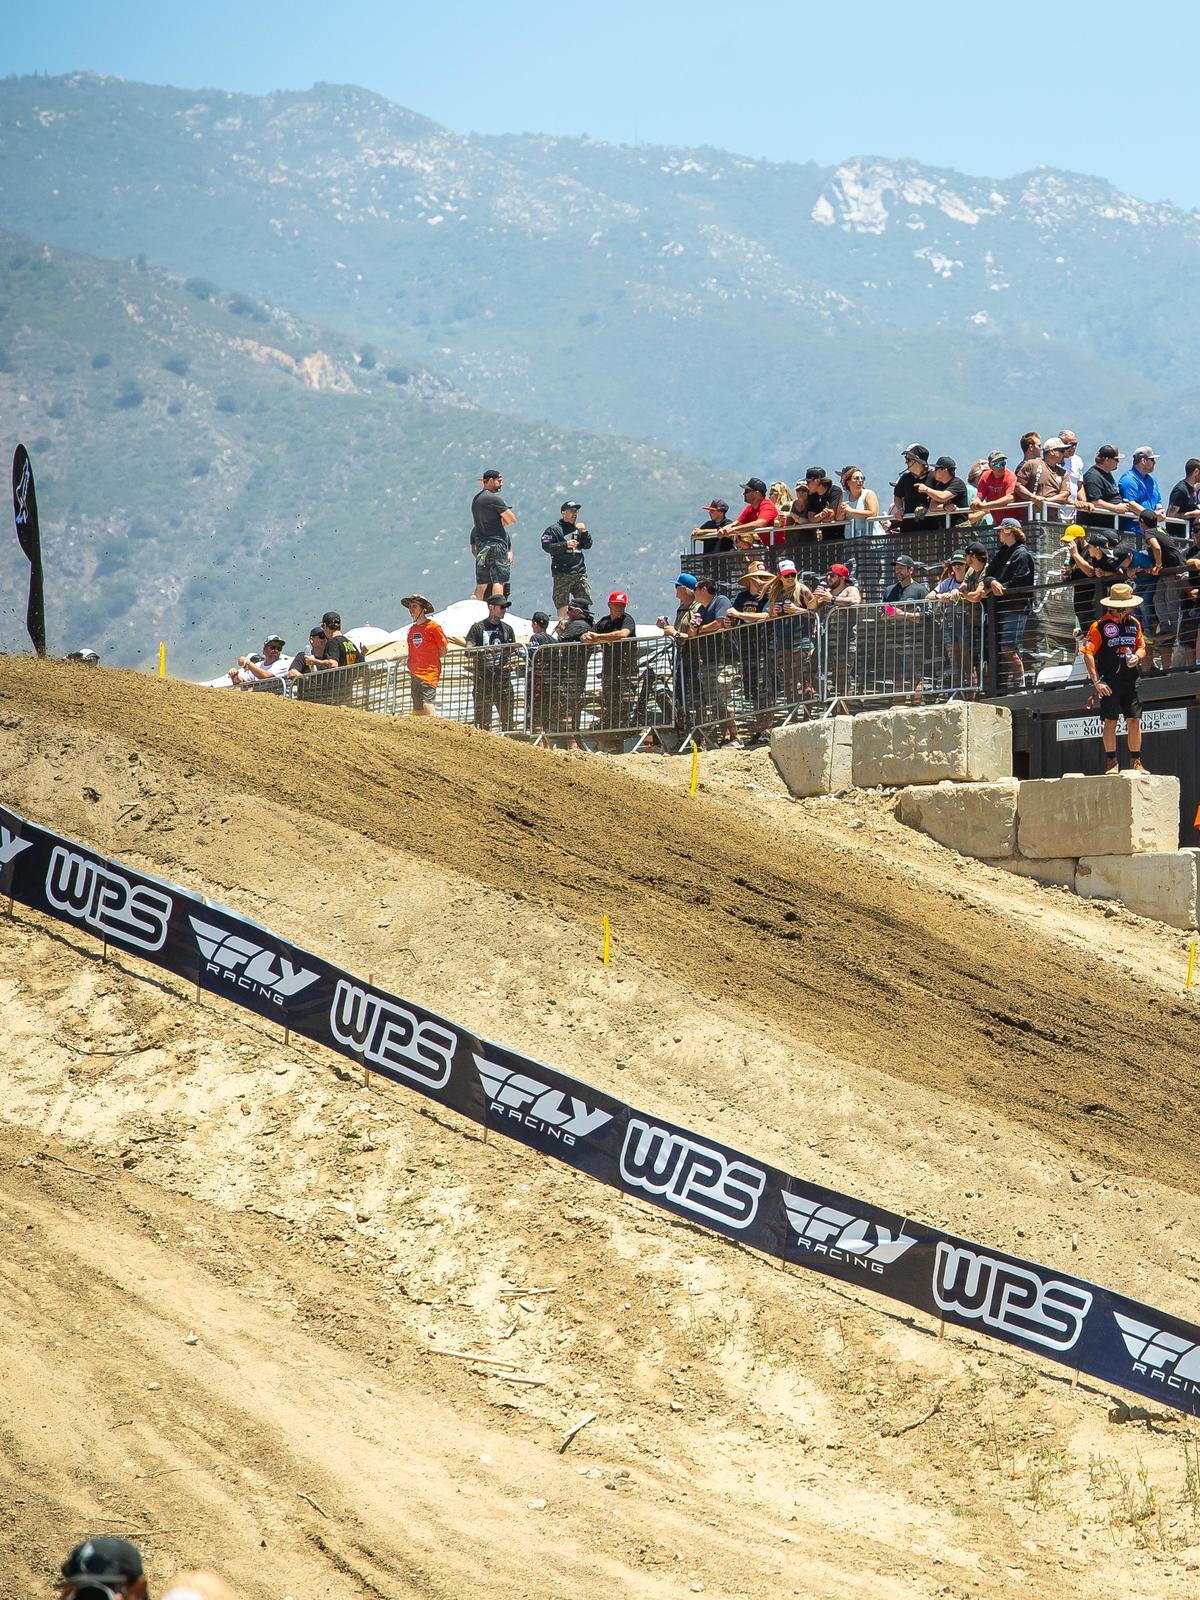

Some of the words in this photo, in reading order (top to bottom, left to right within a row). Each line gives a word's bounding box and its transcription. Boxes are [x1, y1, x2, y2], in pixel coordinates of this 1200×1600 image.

[1083, 726, 1104, 736] 800
[45, 844, 173, 952] WPS
[189, 915, 321, 996] FLY
[207, 963, 284, 1005] RACING
[330, 978, 457, 1089] WPS
[472, 1052, 612, 1135] FLY
[490, 1101, 576, 1145] RACING
[619, 1118, 766, 1229] WPS
[781, 1190, 918, 1264] FLY
[798, 1237, 883, 1274] RACING
[933, 1241, 1093, 1352] WPS
